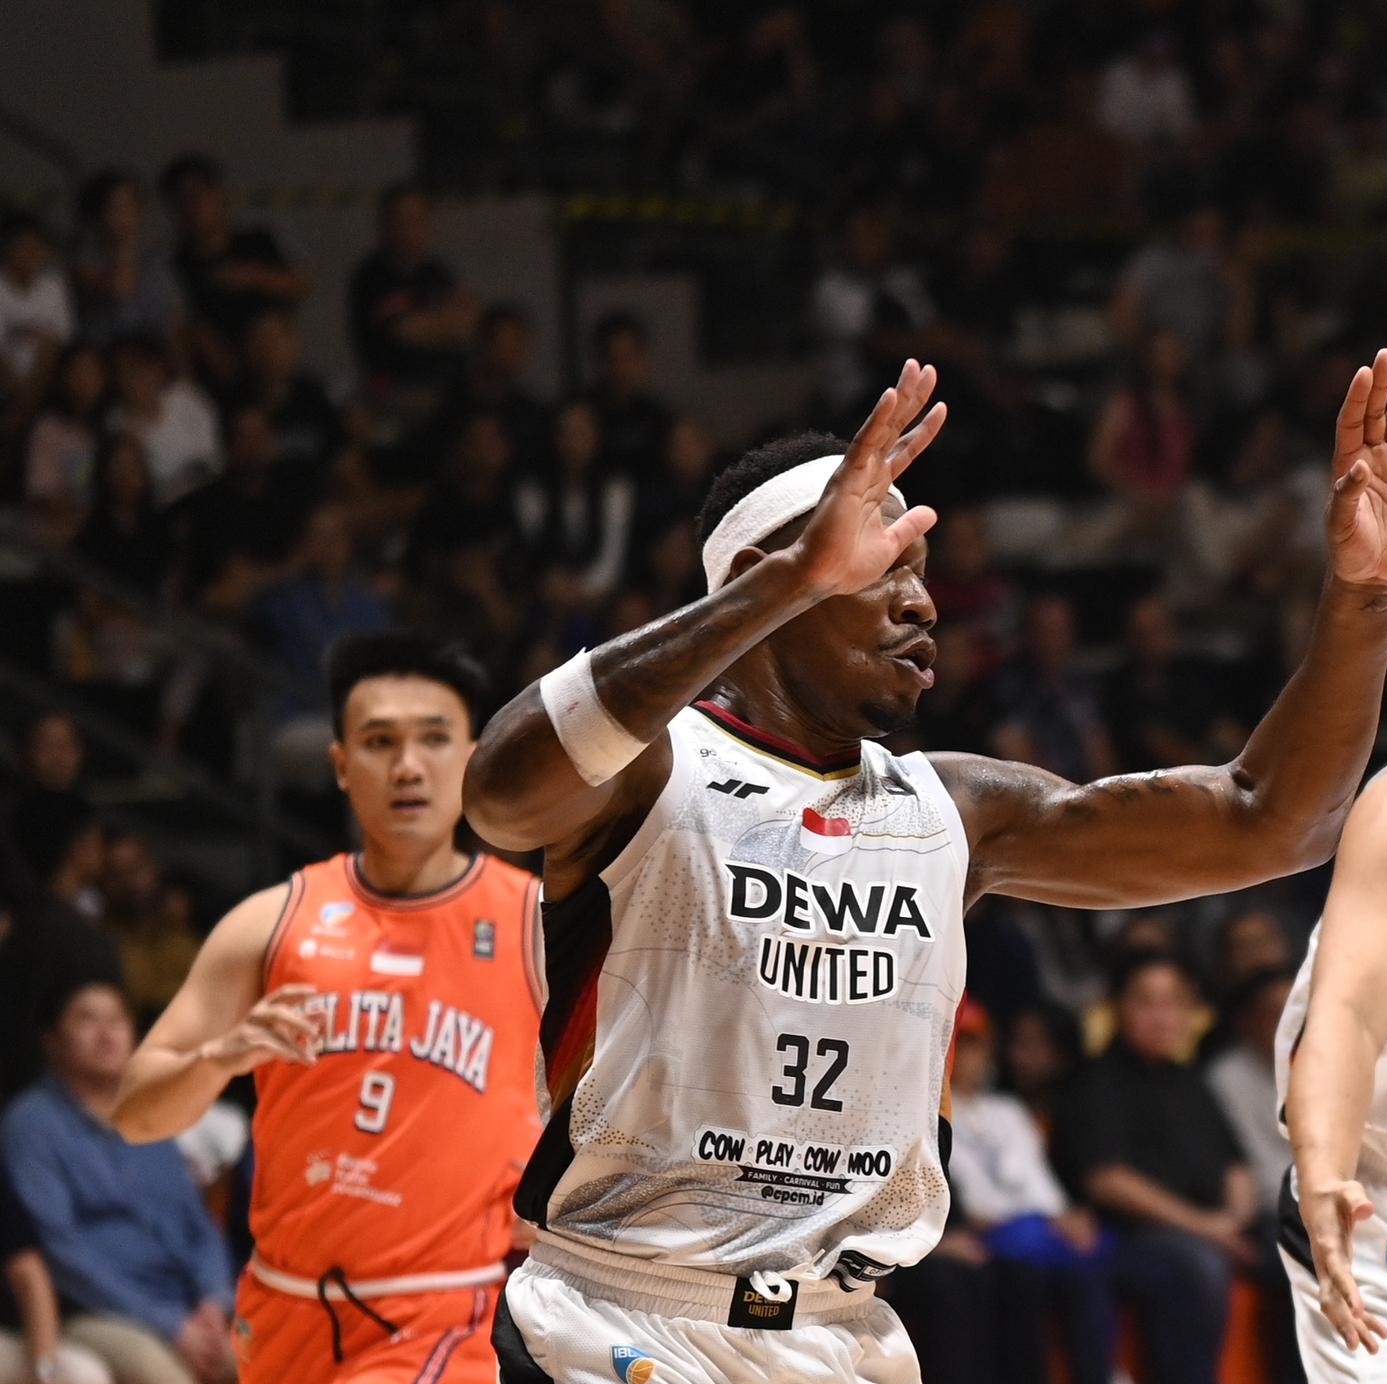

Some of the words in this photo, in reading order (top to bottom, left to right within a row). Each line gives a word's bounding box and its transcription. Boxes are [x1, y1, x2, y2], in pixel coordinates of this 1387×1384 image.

[725, 864, 931, 938] DEWA
[760, 937, 893, 1001] UNITED
[303, 990, 404, 1055] ELITA
[410, 1000, 495, 1093] JAYA
[771, 1033, 850, 1113] 32
[355, 1070, 396, 1135] 9
[698, 1130, 745, 1162] COW
[755, 1139, 794, 1168] PLAY
[803, 1146, 842, 1174] COW
[847, 1150, 891, 1177] MOO
[747, 1171, 777, 1183] FAMILY
[761, 1185, 825, 1206] @cpcm.id
[743, 1290, 789, 1304] DE
[748, 1304, 780, 1318] UNITED
[613, 1347, 637, 1359] IBL
